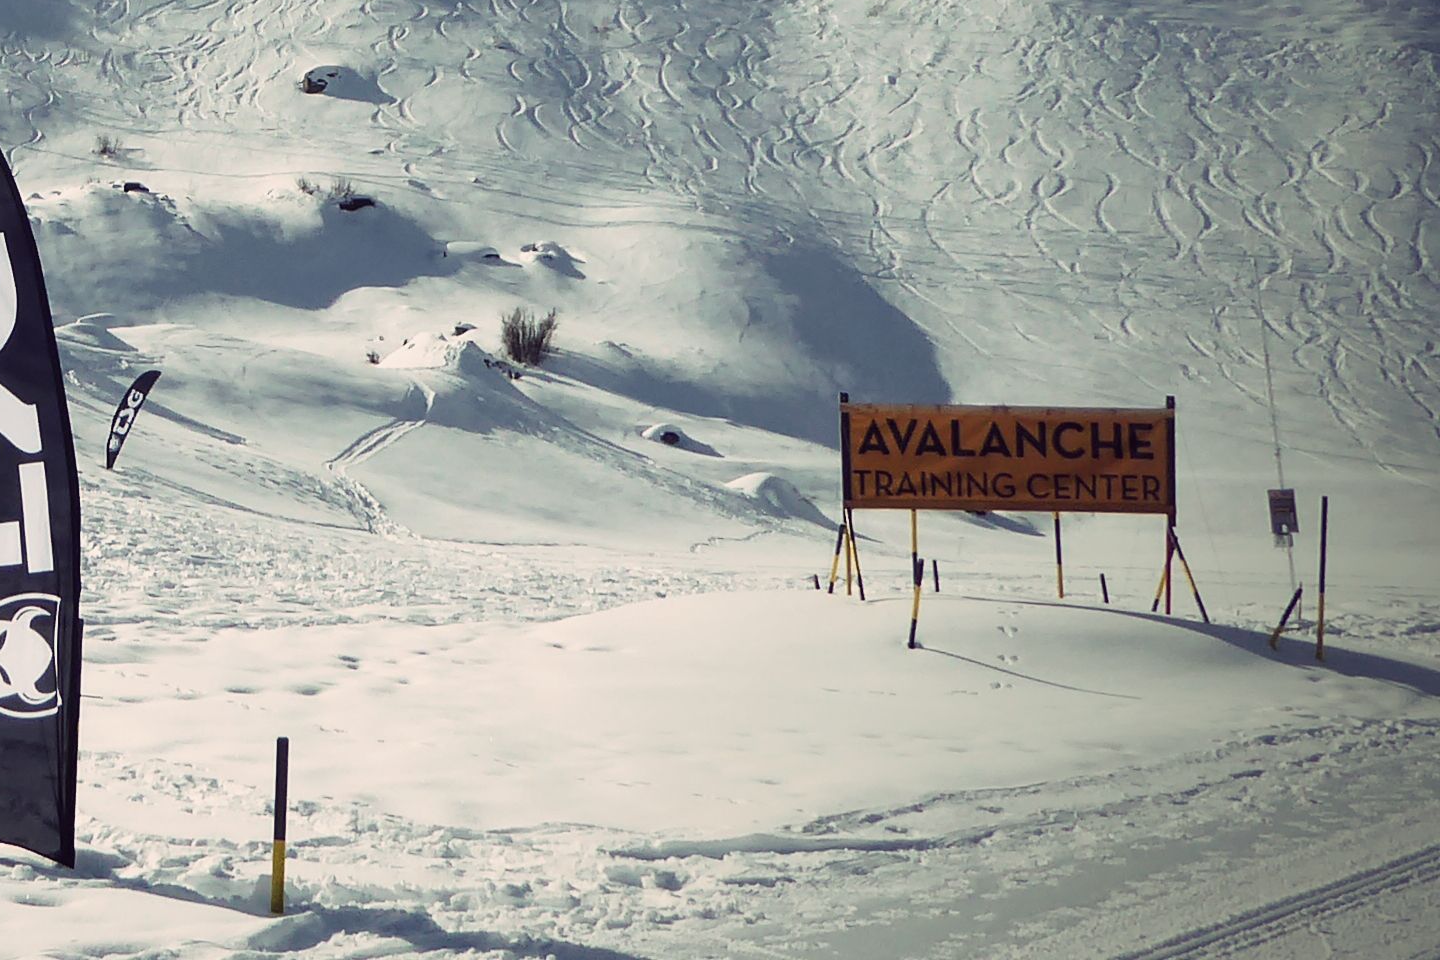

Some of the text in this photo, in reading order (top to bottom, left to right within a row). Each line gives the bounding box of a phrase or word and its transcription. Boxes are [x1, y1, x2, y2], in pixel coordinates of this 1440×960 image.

[858, 418, 1155, 460] AVALANCHE
[853, 470, 1160, 501] TRAINING CENTER
